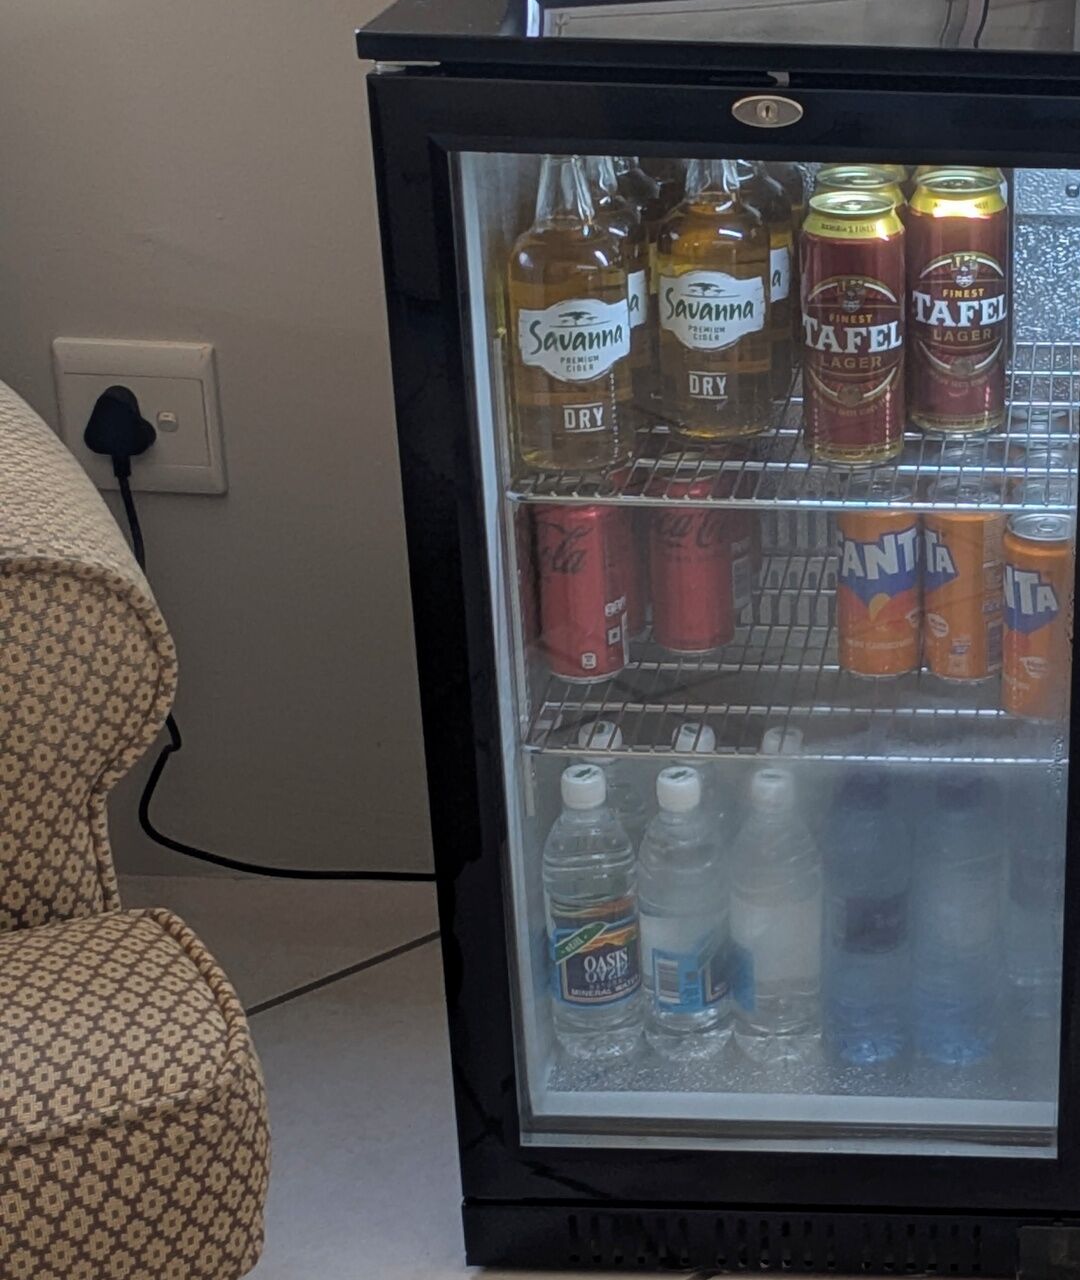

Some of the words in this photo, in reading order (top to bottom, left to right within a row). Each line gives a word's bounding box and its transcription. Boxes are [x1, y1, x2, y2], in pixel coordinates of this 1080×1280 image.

[942, 288, 985, 298] FINEST
[665, 286, 754, 322] Savanna
[912, 290, 1008, 327] TAFEL
[829, 314, 873, 323] FINEST
[688, 325, 726, 333] PREMIUM
[802, 312, 903, 354] TAFEL
[933, 328, 992, 342] LAGER
[529, 320, 624, 355] Savanna
[693, 333, 720, 341] CIDER
[560, 355, 599, 363] PREMIUM
[820, 355, 882, 369] LAGER
[566, 363, 594, 373] CIDER
[689, 374, 727, 396] DRY
[564, 406, 605, 429] DRY
[584, 947, 628, 972] OASIS
